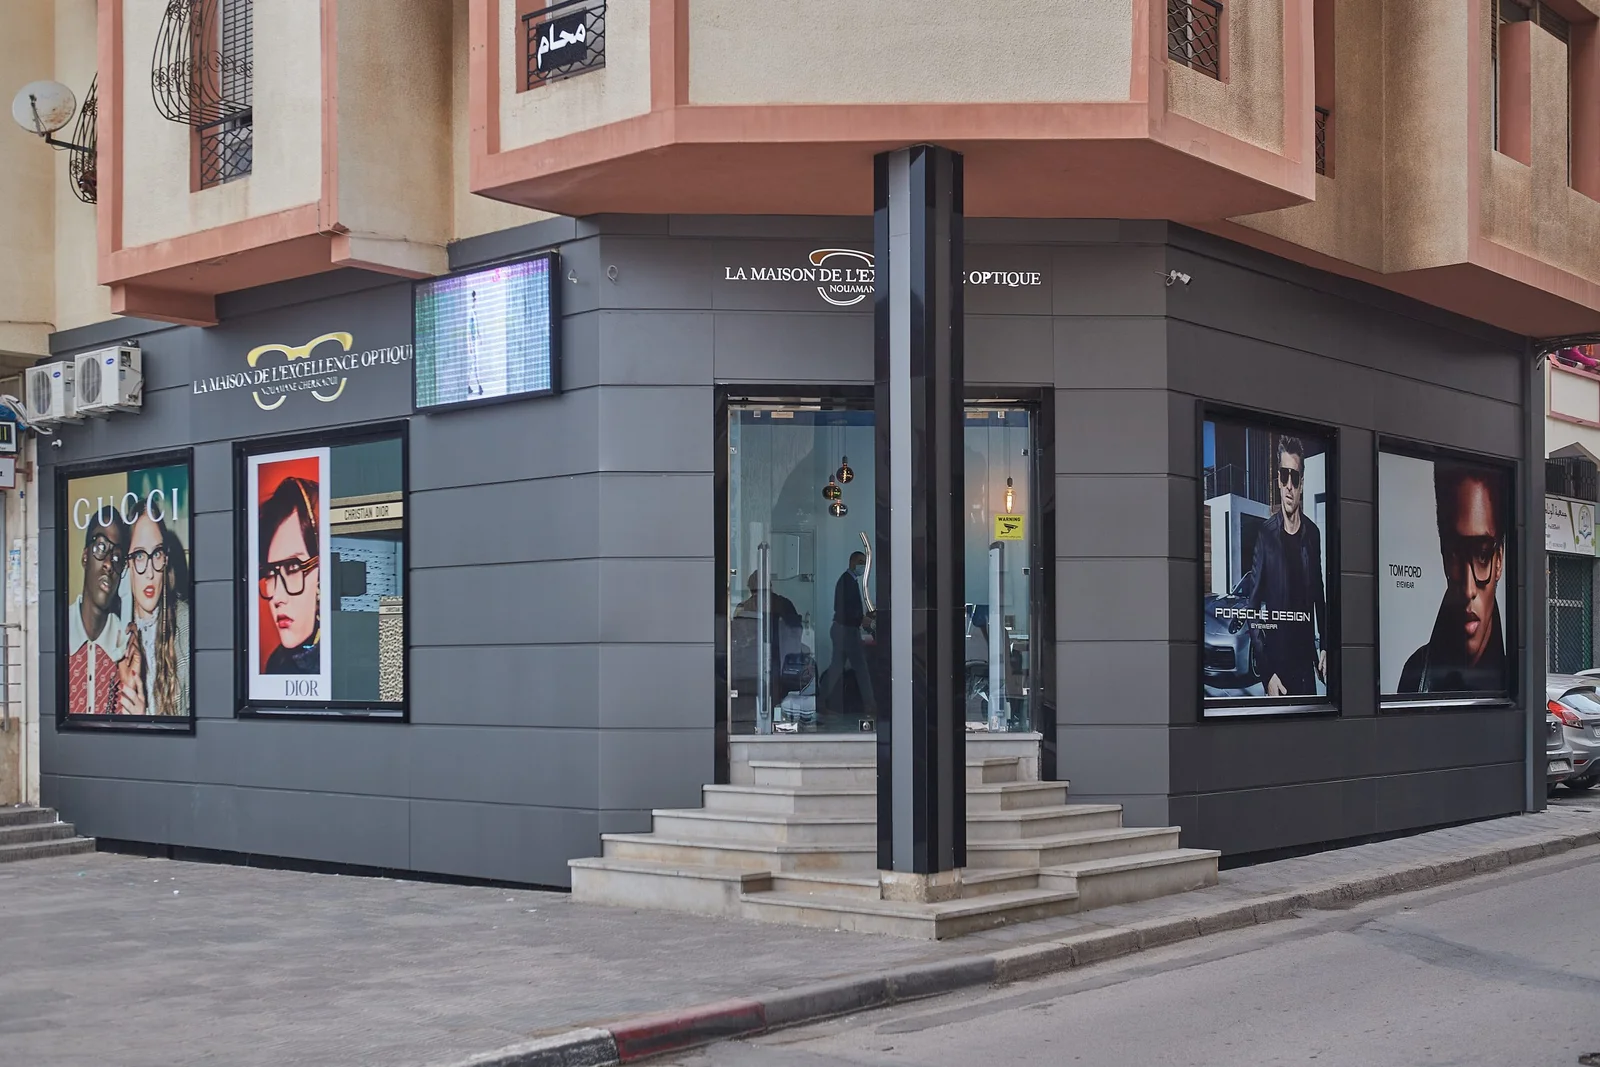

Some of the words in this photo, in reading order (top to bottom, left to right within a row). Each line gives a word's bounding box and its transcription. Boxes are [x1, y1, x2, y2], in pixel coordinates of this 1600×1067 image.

[537, 23, 586, 70] محام
[725, 267, 747, 280] LA
[750, 267, 816, 282] MAISON
[819, 268, 841, 282] DE
[969, 271, 1041, 287] OPTIQUE
[193, 379, 208, 394] LA
[209, 371, 252, 392] MAISON
[254, 368, 270, 385] DE
[272, 353, 359, 381] L'EXCELLENCE
[73, 487, 179, 530] GUCCI
[344, 507, 373, 520] CHRISTIAN
[375, 505, 389, 518] DIOR
[1388, 564, 1403, 576] TOM
[1404, 565, 1422, 578] FORD
[1396, 580, 1415, 588] EYEWEAR
[1215, 607, 1269, 620] PORSCHE
[1271, 610, 1311, 622] DESIGN
[1250, 622, 1278, 630] EYEWEAR
[285, 679, 319, 696] DIOR
